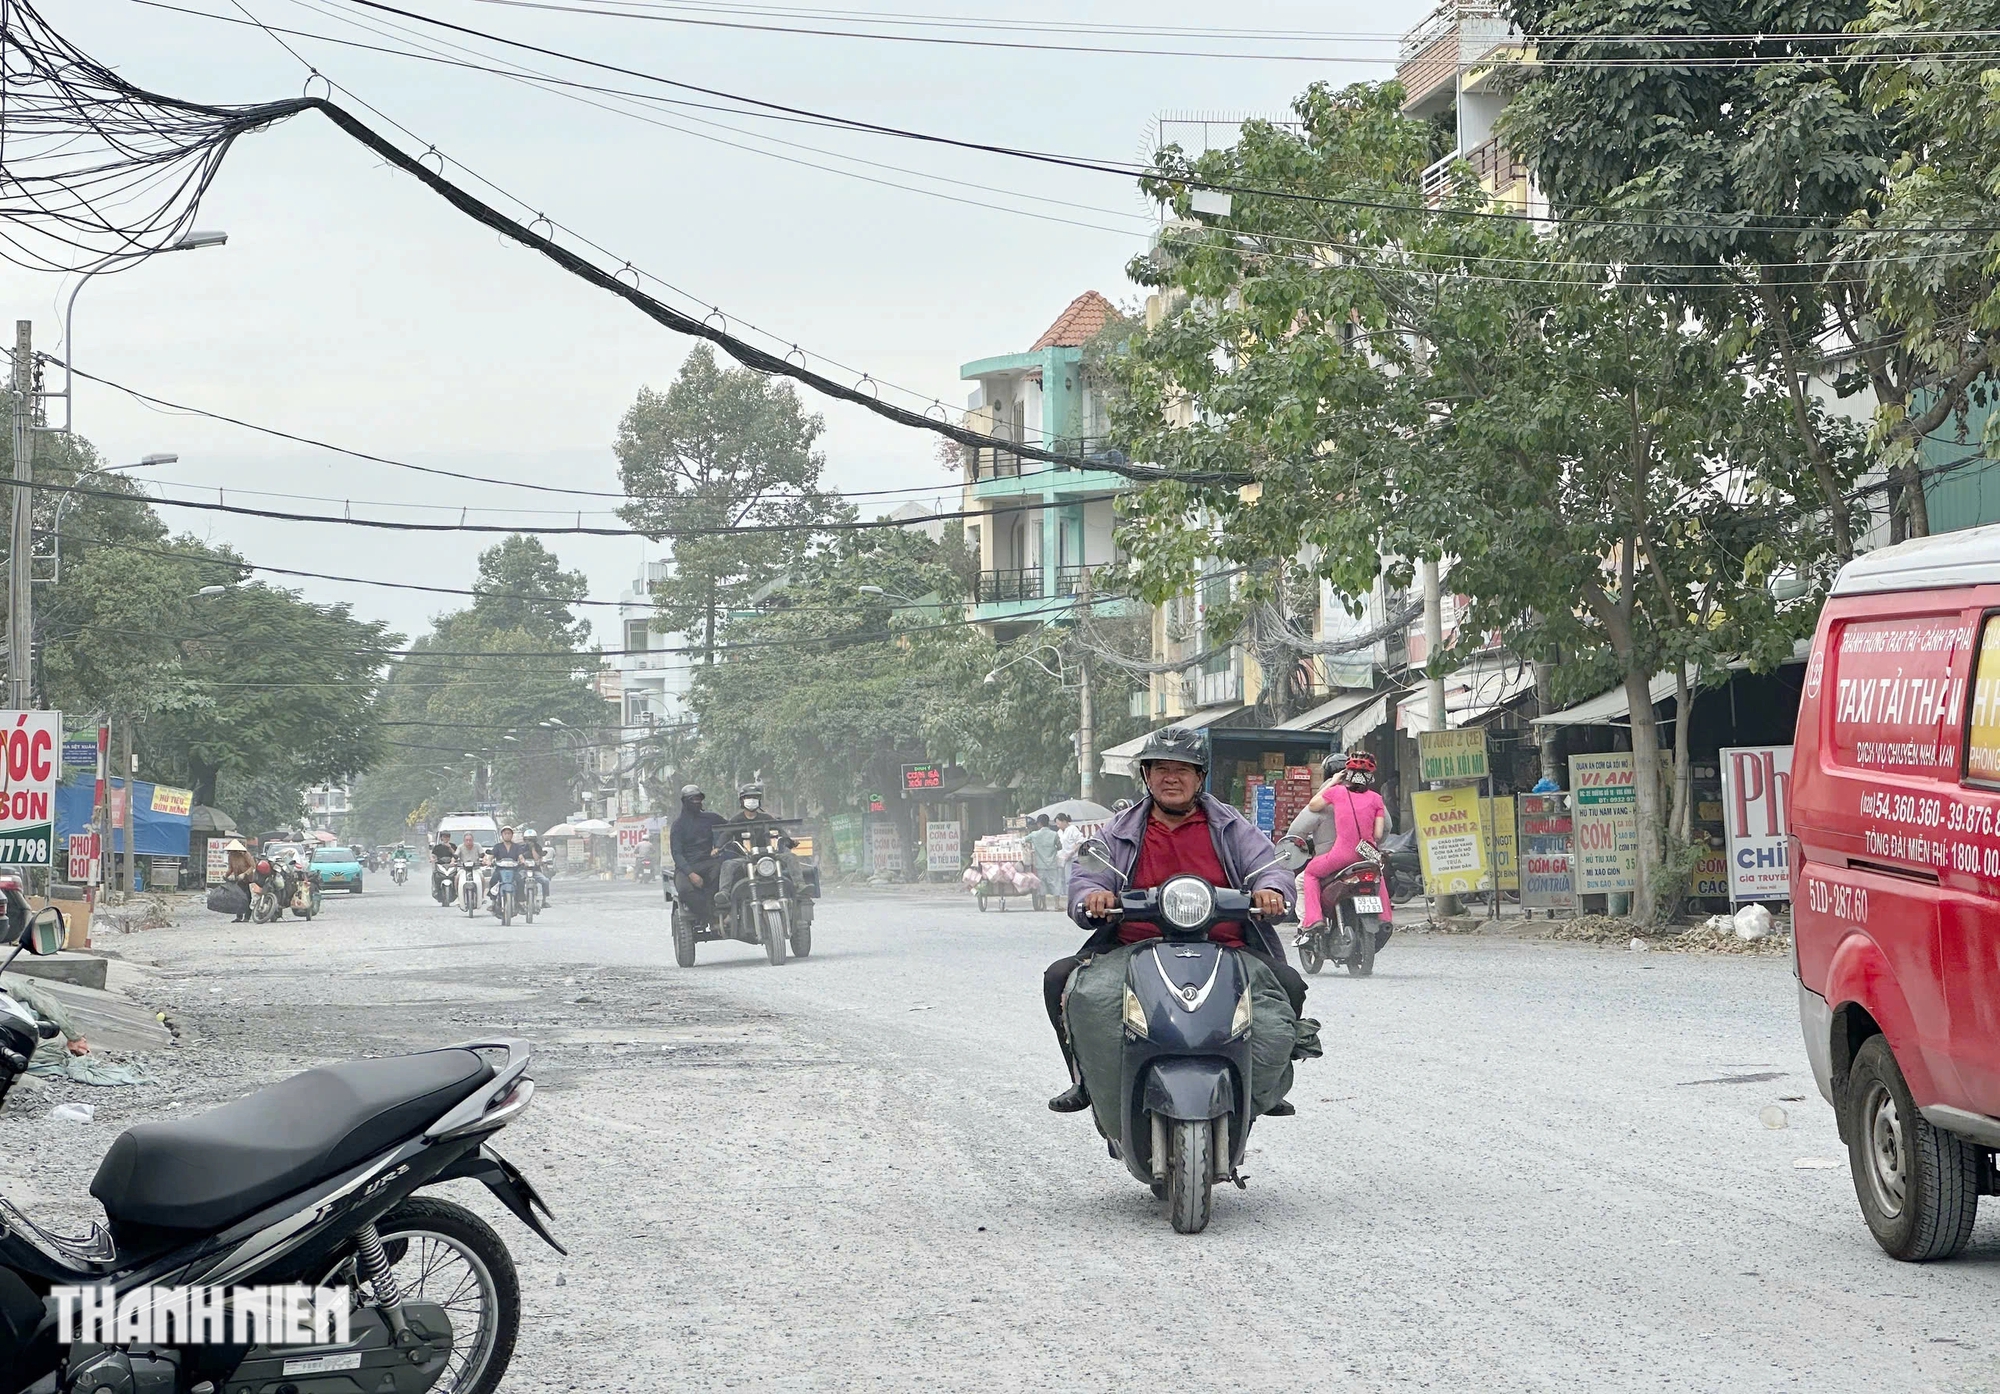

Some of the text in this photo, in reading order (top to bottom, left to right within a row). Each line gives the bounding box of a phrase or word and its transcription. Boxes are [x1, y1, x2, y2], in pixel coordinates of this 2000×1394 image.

[1837, 679, 1877, 723] TAXI
[1877, 667, 1909, 724] TẢI
[1422, 734, 1431, 749] VI
[1433, 732, 1454, 749] ANH
[1456, 731, 1463, 747] 2
[1857, 741, 1875, 767] DỊCH
[1875, 742, 1887, 769] VỤ
[1887, 737, 1919, 765] CHUYỂN
[1425, 754, 1442, 778] CƠM
[1444, 752, 1454, 776] GÀ
[1457, 749, 1470, 775] XỐI
[1581, 771, 1634, 786] VI AN
[1730, 751, 1790, 838] Ph
[1600, 807, 1612, 815] NAM
[1613, 806, 1628, 815] VANG
[1423, 826, 1437, 837] VI
[1439, 823, 1468, 836] ANH
[1470, 822, 1478, 832] 2
[1580, 818, 1612, 850] CƠM
[17, 838, 47, 863] 798
[70, 836, 100, 856] PHO
[1891, 831, 1907, 860] ĐÀI
[70, 859, 100, 879] CO
[1528, 857, 1549, 873] CƠM
[1698, 877, 1728, 894] CÁC
[1758, 869, 1789, 882] TRUYỀ
